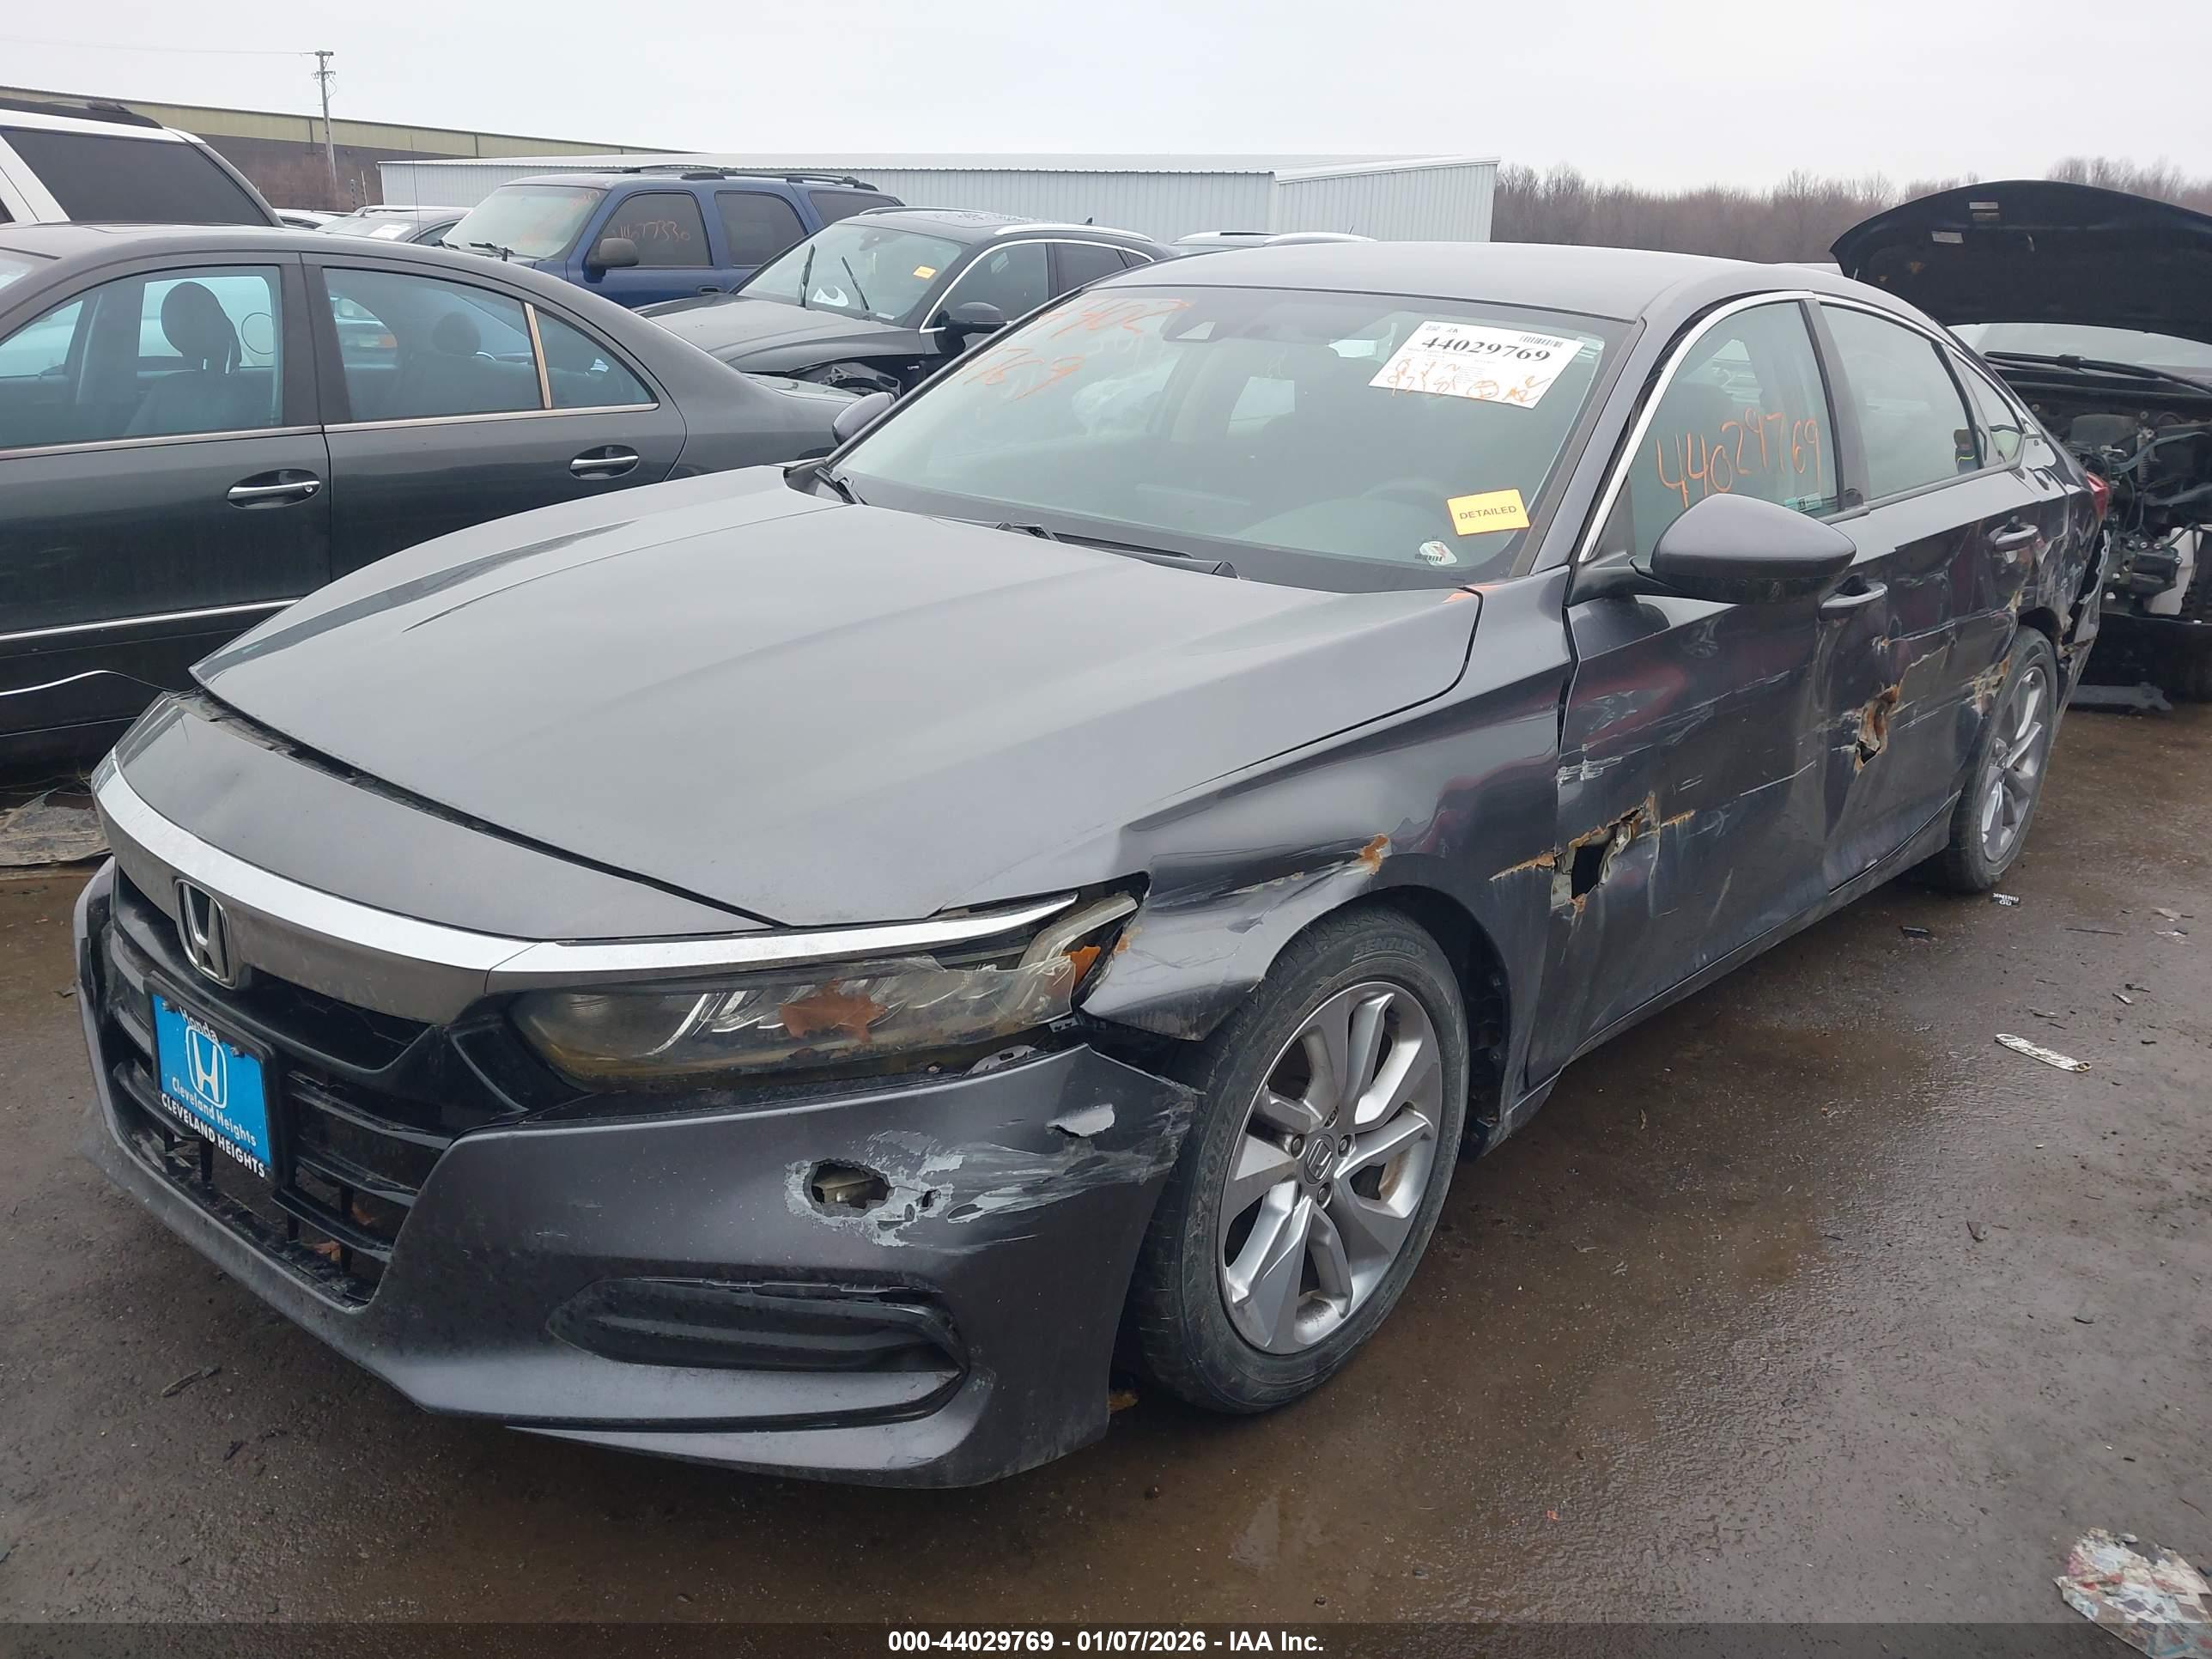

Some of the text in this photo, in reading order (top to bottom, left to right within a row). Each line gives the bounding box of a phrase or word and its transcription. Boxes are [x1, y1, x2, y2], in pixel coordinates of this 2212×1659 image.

[1421, 336, 1551, 362] 44029769
[1656, 407, 1822, 508] 44029769
[1459, 505, 1517, 520] DETAILED
[161, 1092, 265, 1178] CLEVELAND HEIGHTS
[172, 1076, 257, 1147] Cleveland Heights
